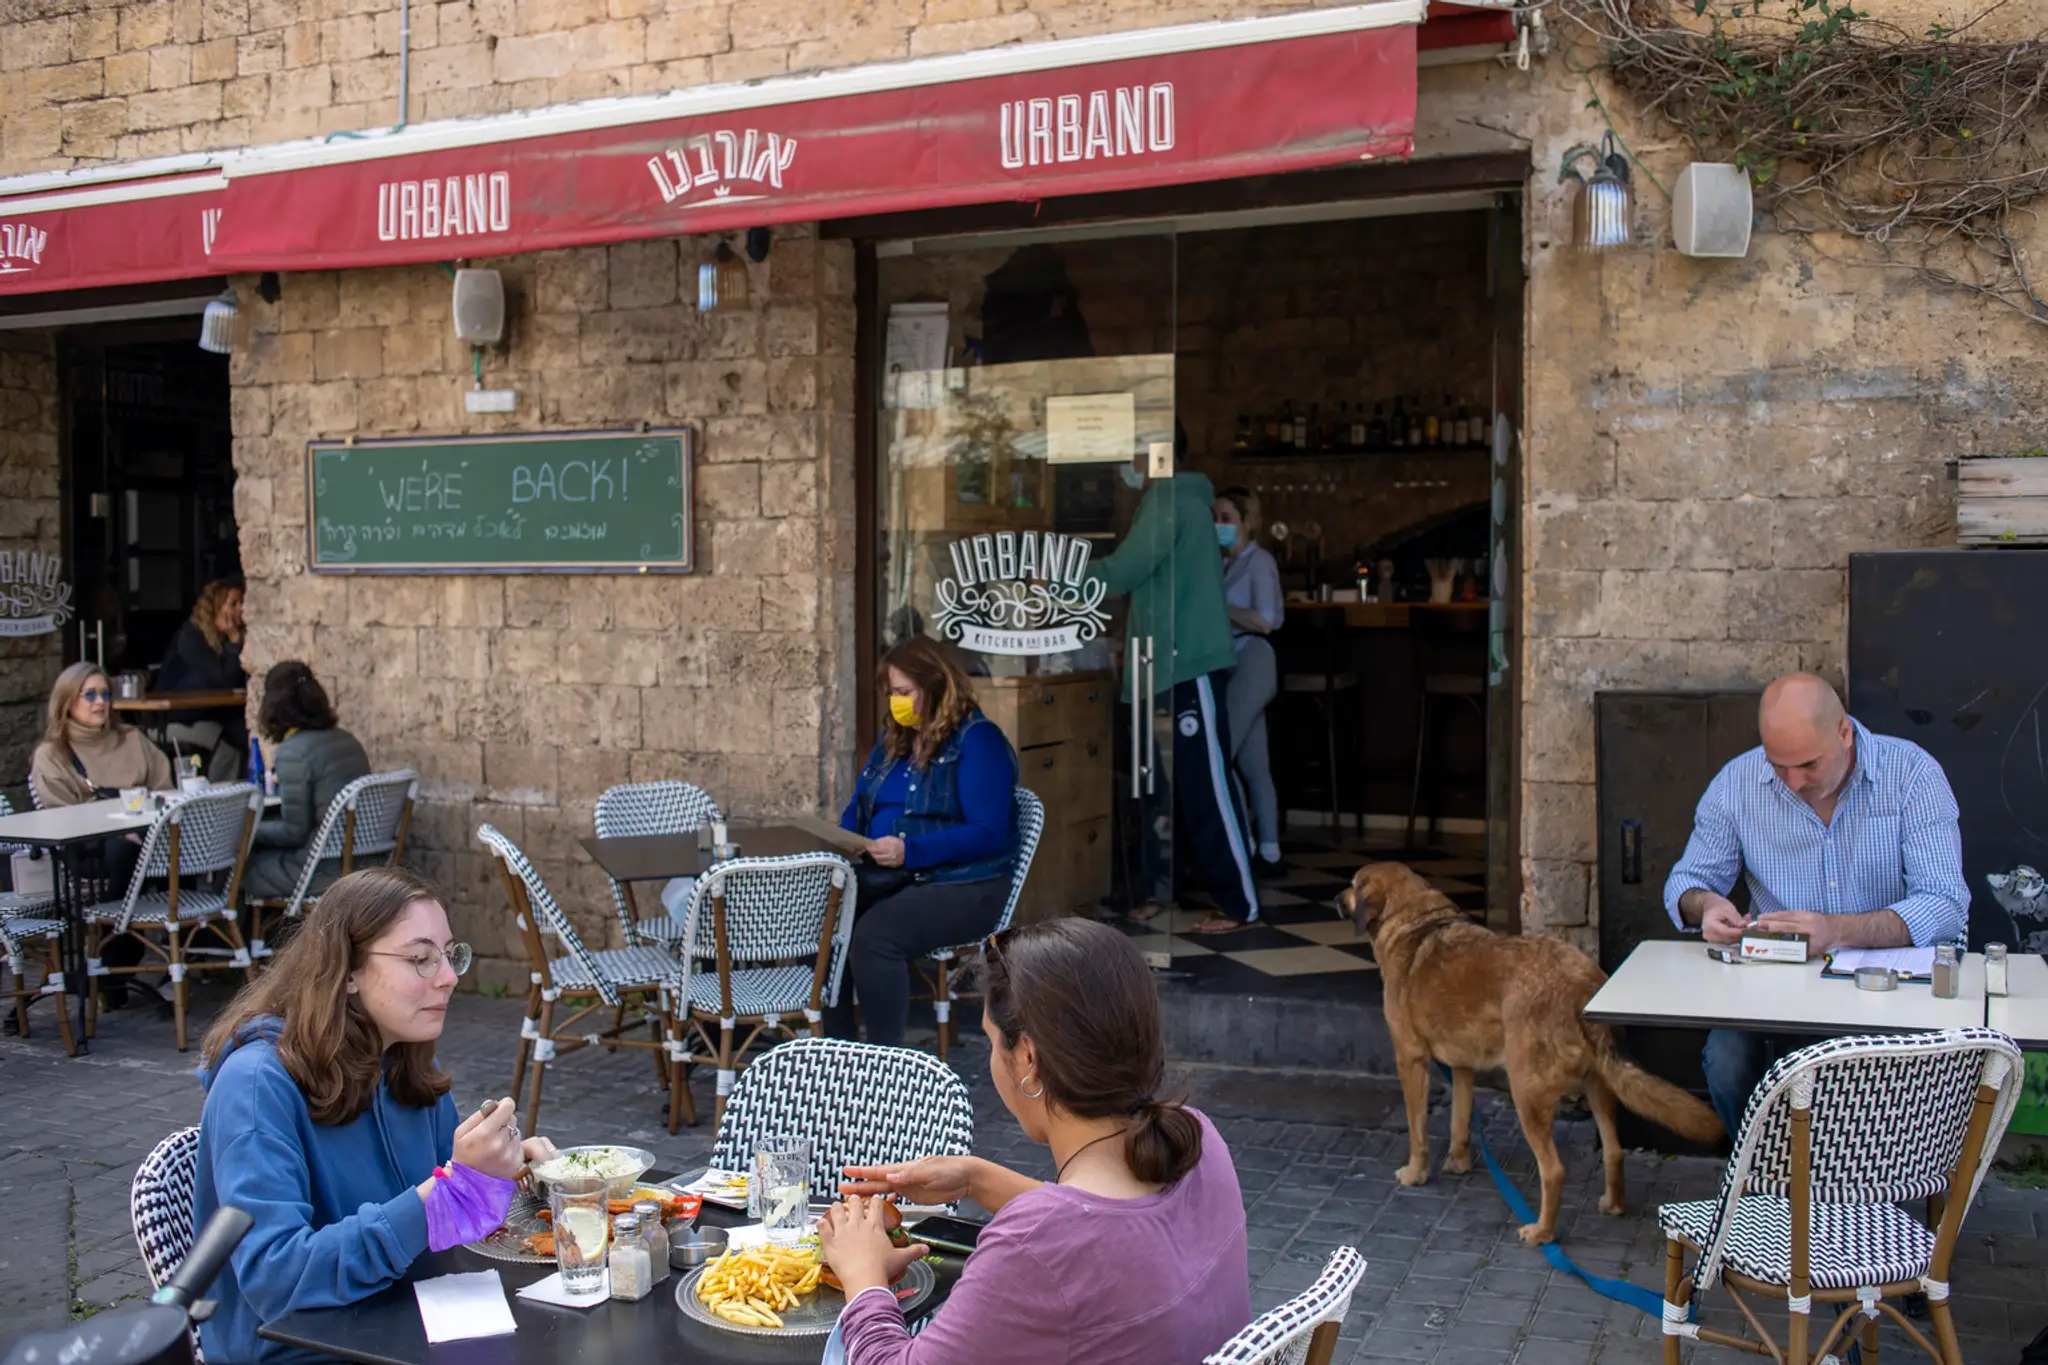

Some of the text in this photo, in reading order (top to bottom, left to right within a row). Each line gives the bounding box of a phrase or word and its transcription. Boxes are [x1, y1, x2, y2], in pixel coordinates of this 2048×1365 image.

[1001, 87, 1175, 169] URBANO
[648, 128, 797, 203] אורבנו
[378, 171, 509, 241] URBANO
[0, 223, 47, 264] אור
[512, 458, 628, 502] BACK!
[948, 530, 1092, 588] URBANO
[974, 633, 1023, 649] KITCHEN
[1044, 634, 1067, 648] BAR
